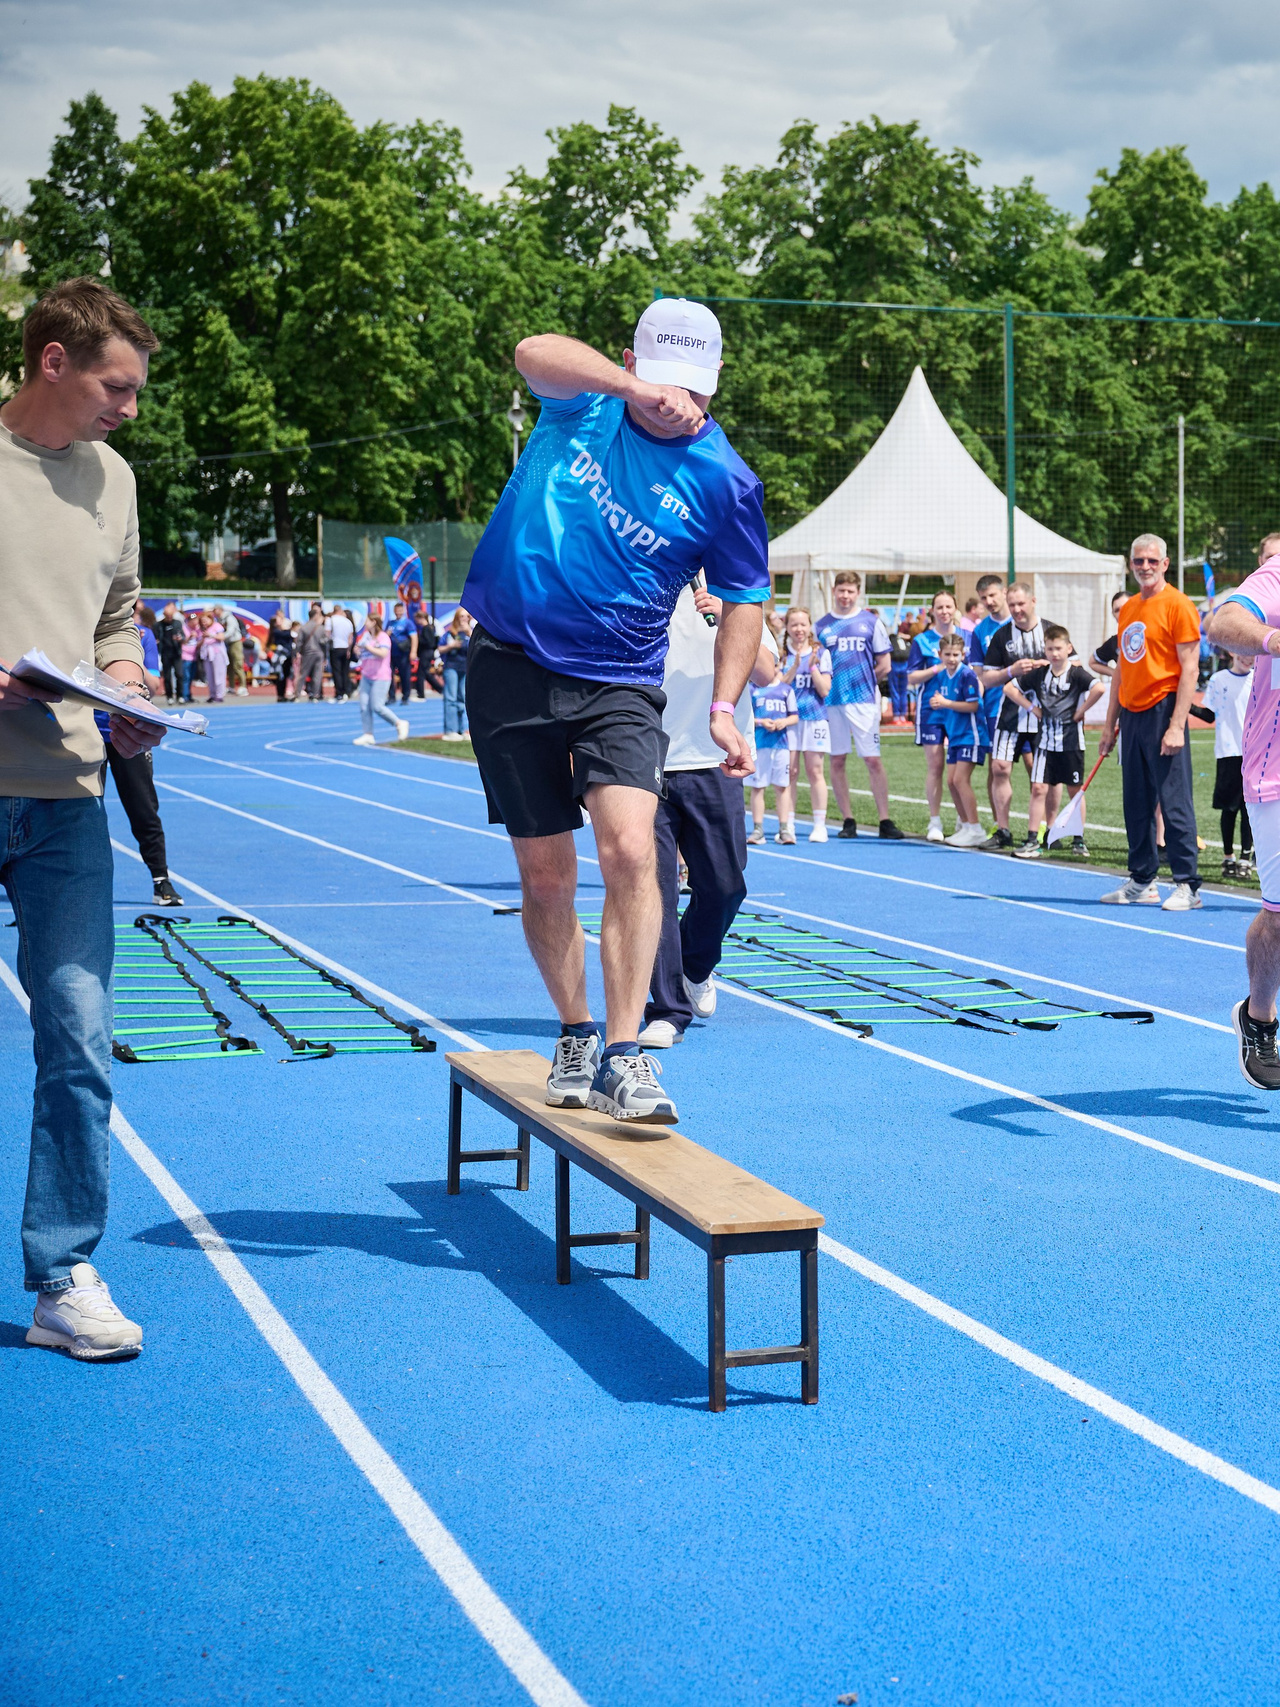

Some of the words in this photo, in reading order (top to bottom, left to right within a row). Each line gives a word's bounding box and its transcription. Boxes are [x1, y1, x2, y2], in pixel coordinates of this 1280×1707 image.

[657, 333, 707, 350] ОРЕНБУРГ
[570, 451, 671, 556] ОРЕНБУРГ
[660, 493, 691, 520] ВТБ
[838, 636, 866, 651] ВТБ
[795, 674, 815, 689] ВТ
[765, 699, 787, 712] ВТБ
[813, 728, 827, 739] 52
[1072, 771, 1080, 783] 3
